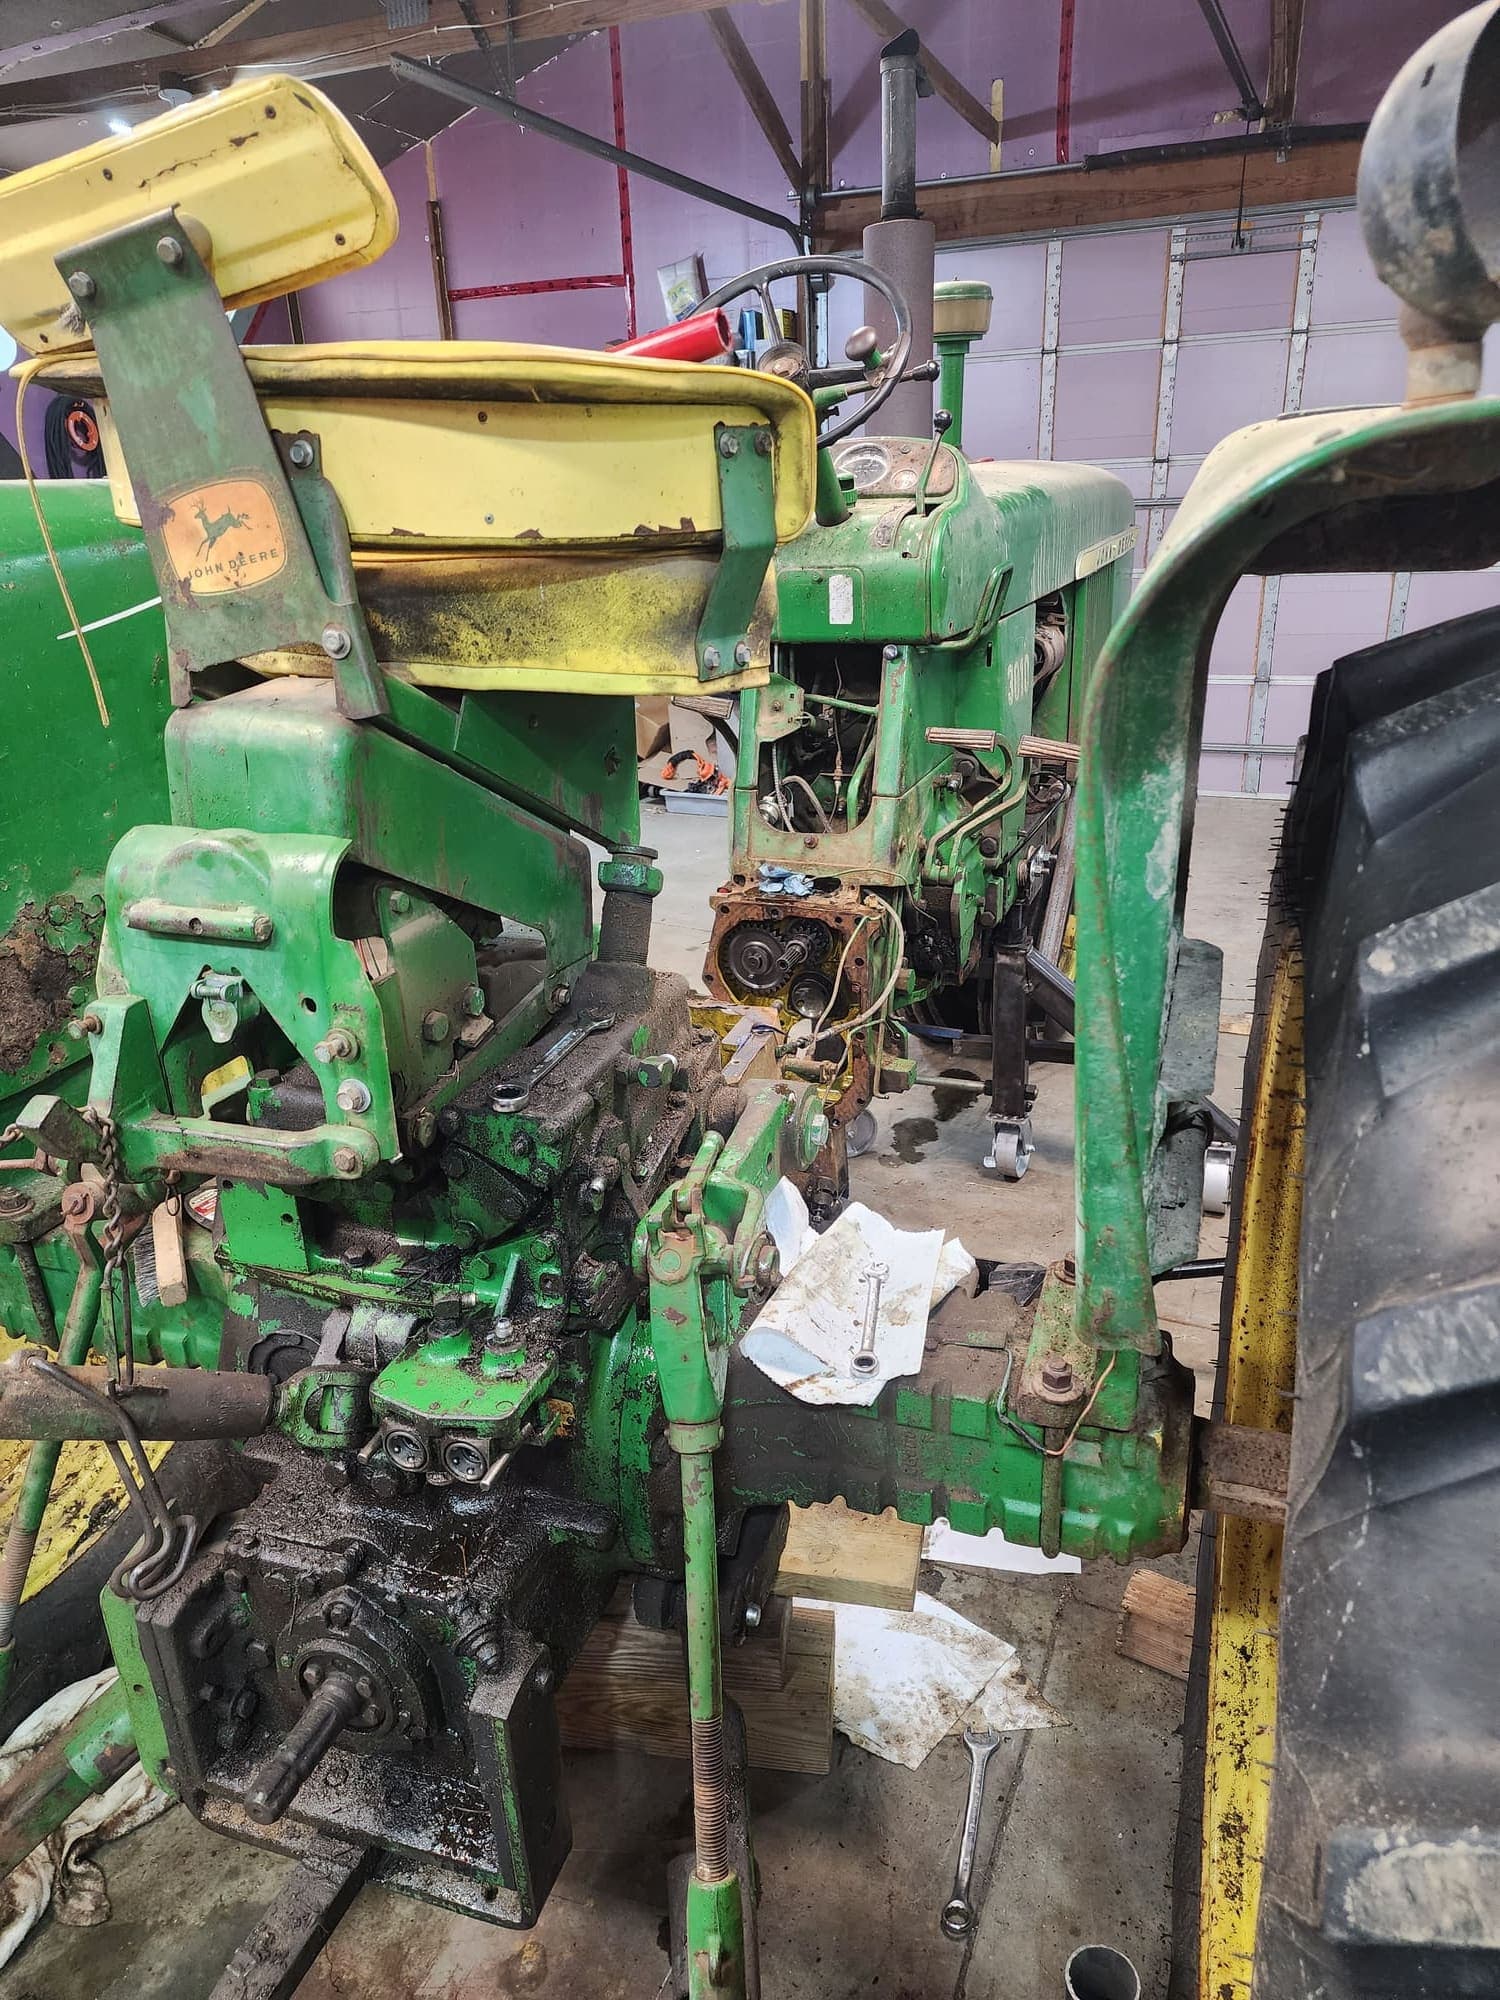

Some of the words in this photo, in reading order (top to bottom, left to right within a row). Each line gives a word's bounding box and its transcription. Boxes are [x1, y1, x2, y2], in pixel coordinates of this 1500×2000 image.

[187, 563, 223, 579] JOHN
[228, 548, 279, 569] DEERE
[1007, 654, 1030, 706] 3010
